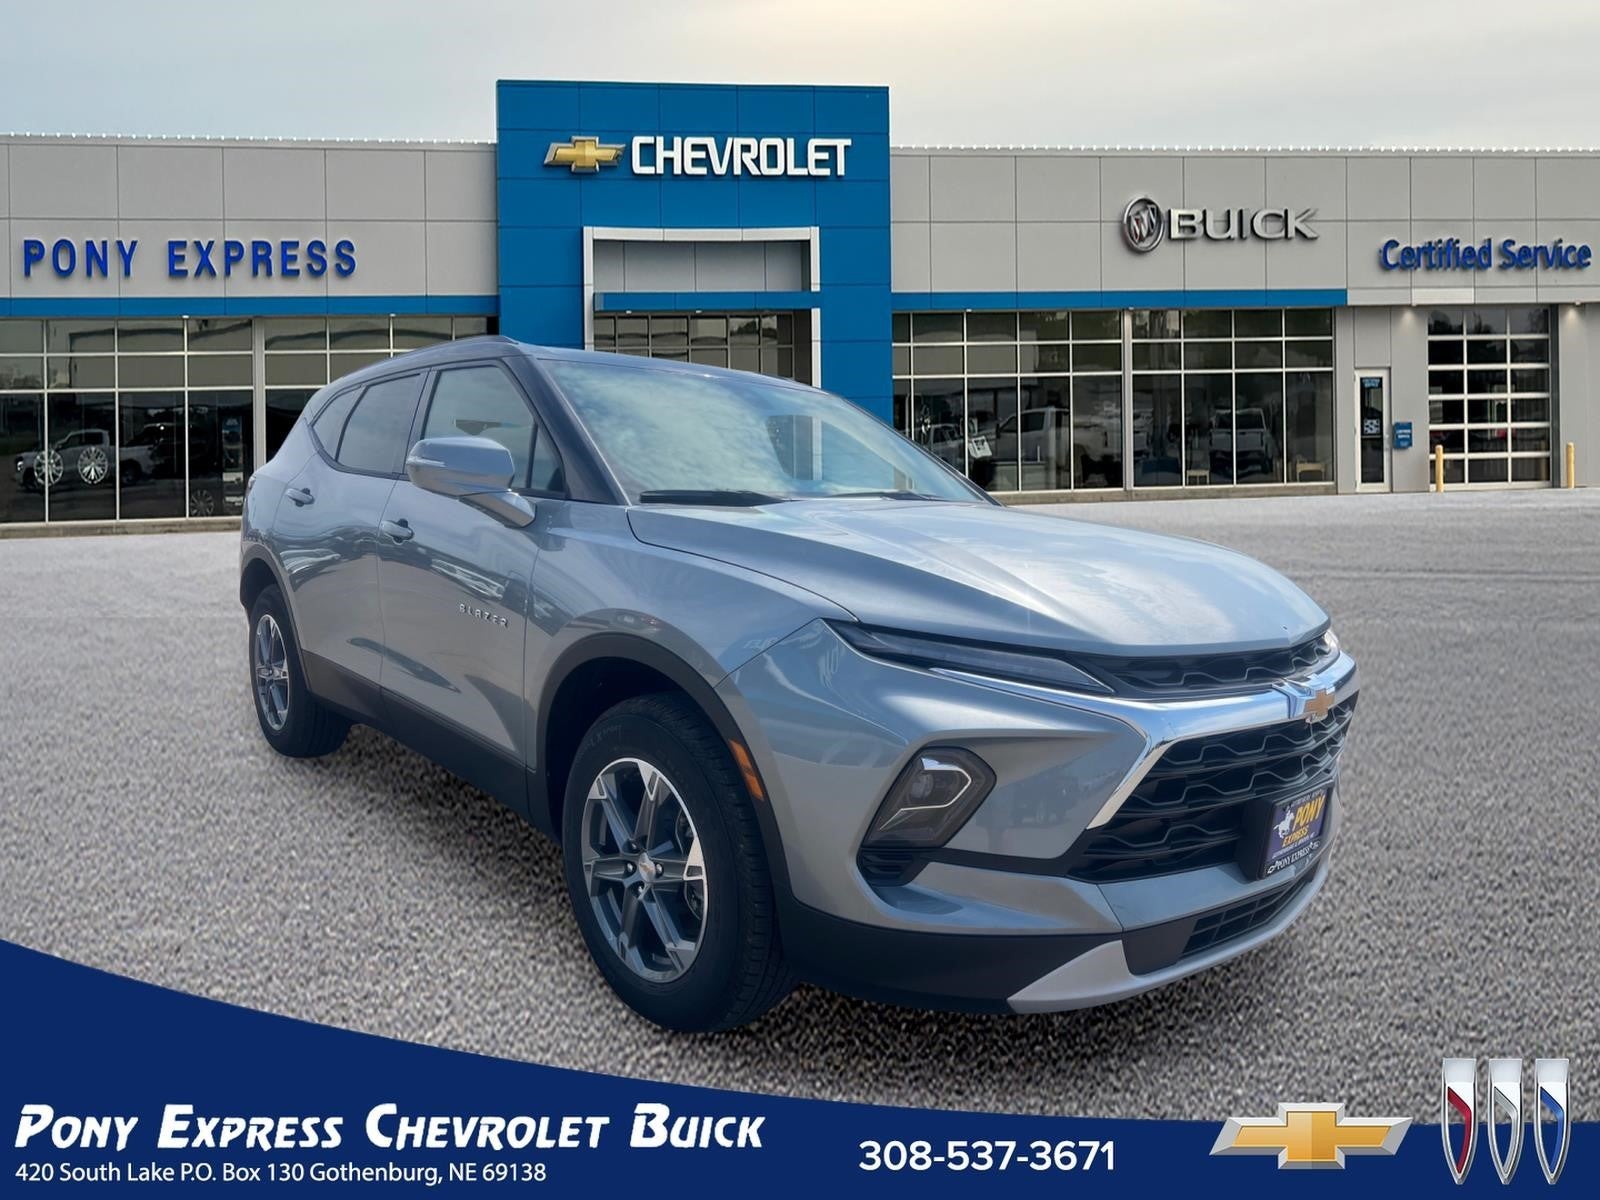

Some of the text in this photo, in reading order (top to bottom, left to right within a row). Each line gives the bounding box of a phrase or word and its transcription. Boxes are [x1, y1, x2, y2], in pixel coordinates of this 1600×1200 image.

[631, 135, 852, 176] CHEVROLET
[1169, 208, 1319, 241] BUICK
[23, 239, 357, 277] PONY EXPRESS
[1381, 239, 1592, 270] Certified Service
[459, 603, 508, 628] BLAZER
[1292, 794, 1326, 832] PONY
[1282, 826, 1309, 848] EXPRESS
